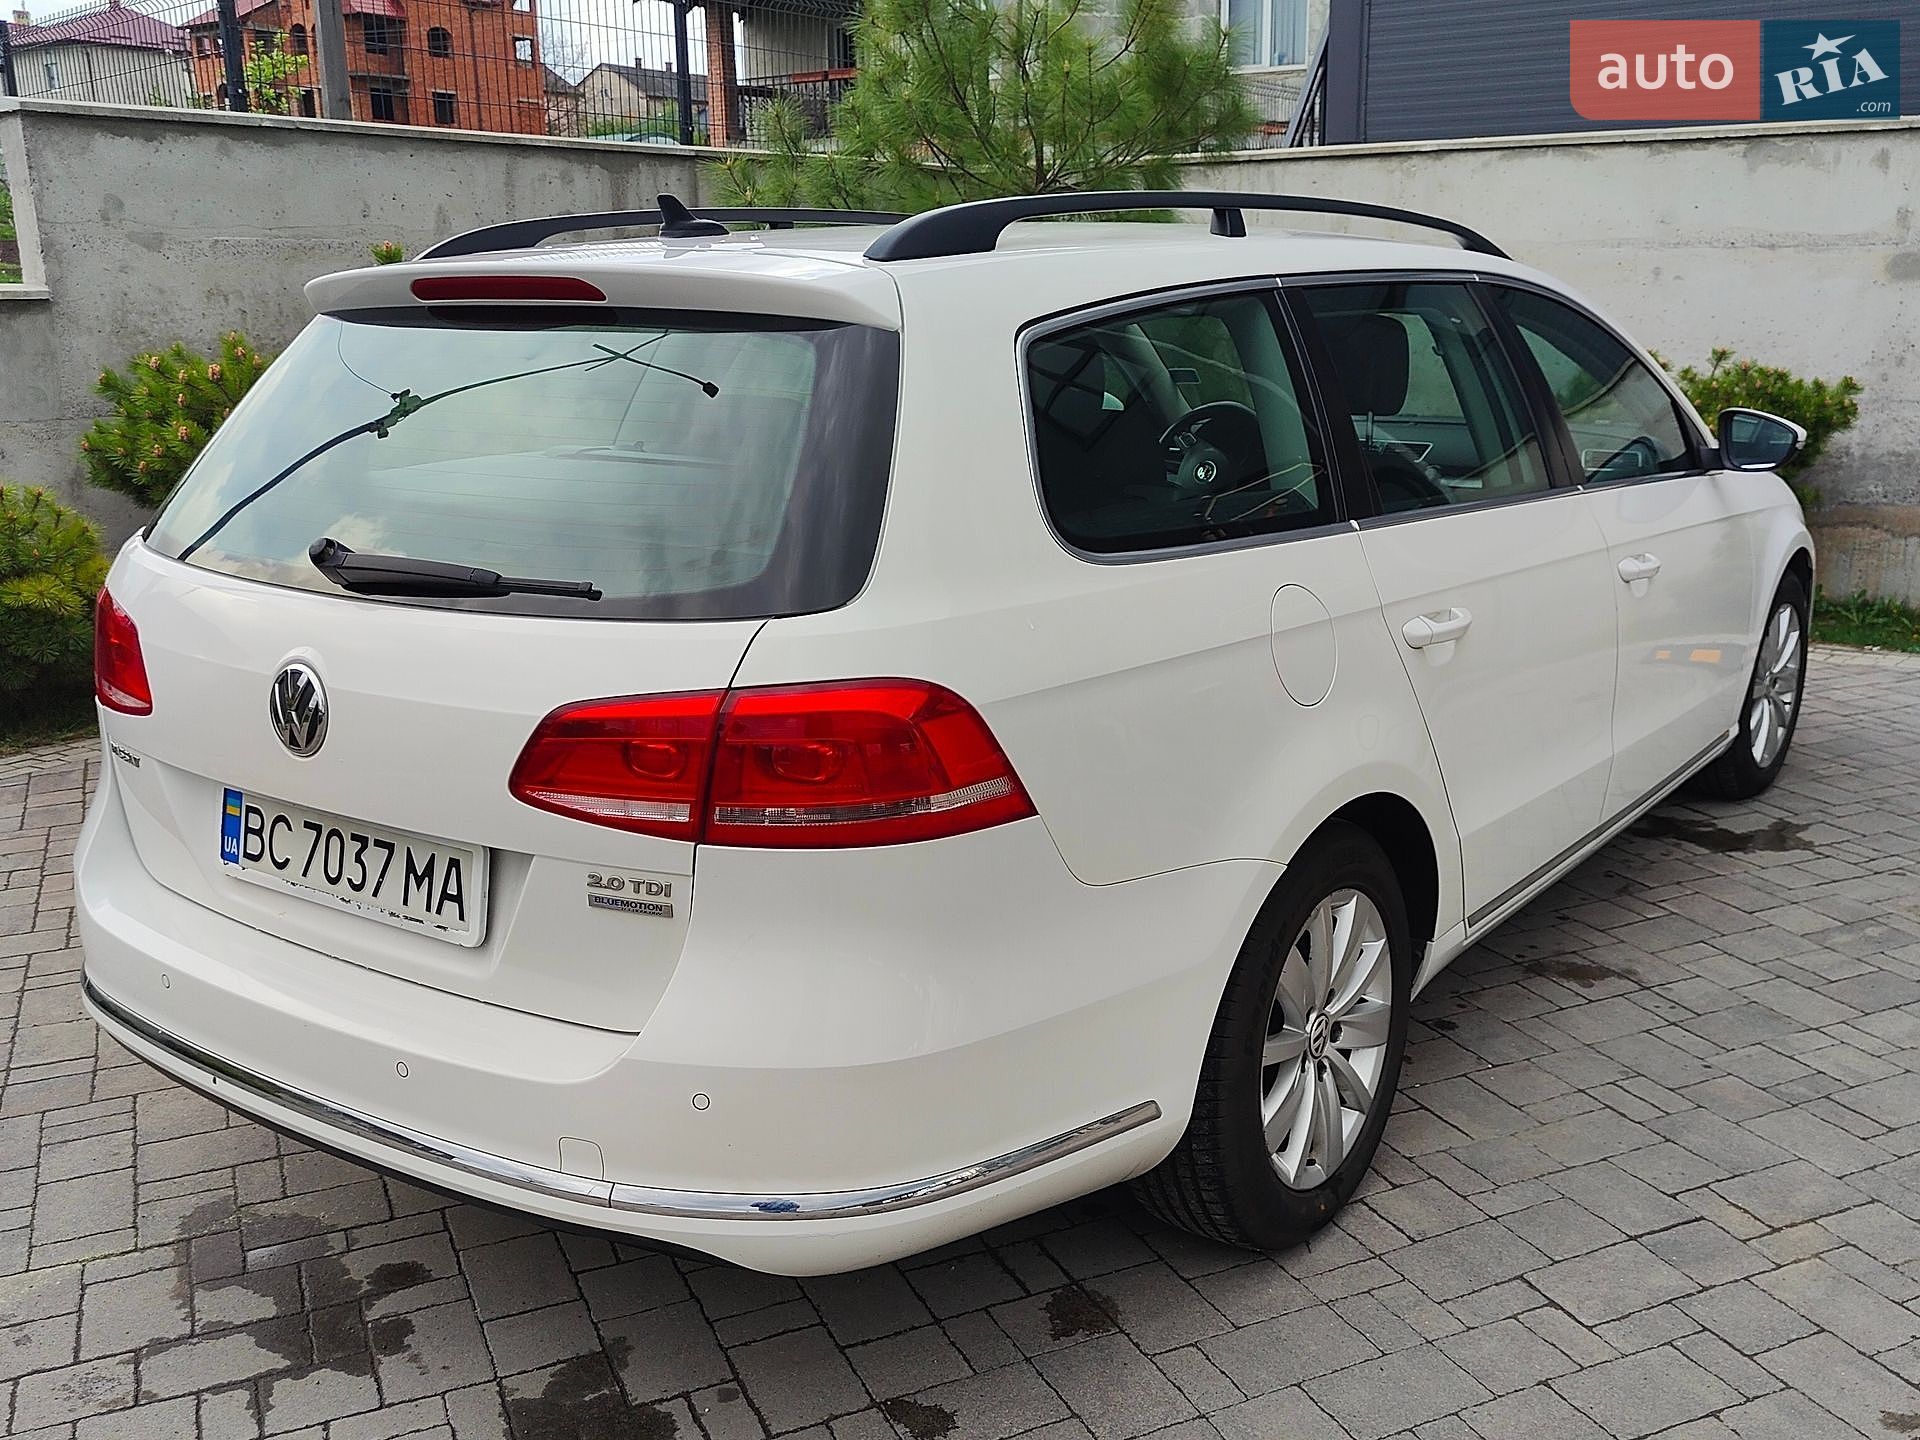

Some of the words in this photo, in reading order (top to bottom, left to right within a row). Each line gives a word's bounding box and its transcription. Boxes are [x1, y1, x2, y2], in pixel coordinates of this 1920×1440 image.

[224, 836, 238, 856] UA
[242, 803, 293, 871] BC
[302, 820, 395, 898] 7037
[402, 846, 465, 922] MA
[587, 872, 625, 891] 2.0
[628, 877, 672, 898] TDI
[594, 896, 663, 912] BLUEMOTION
